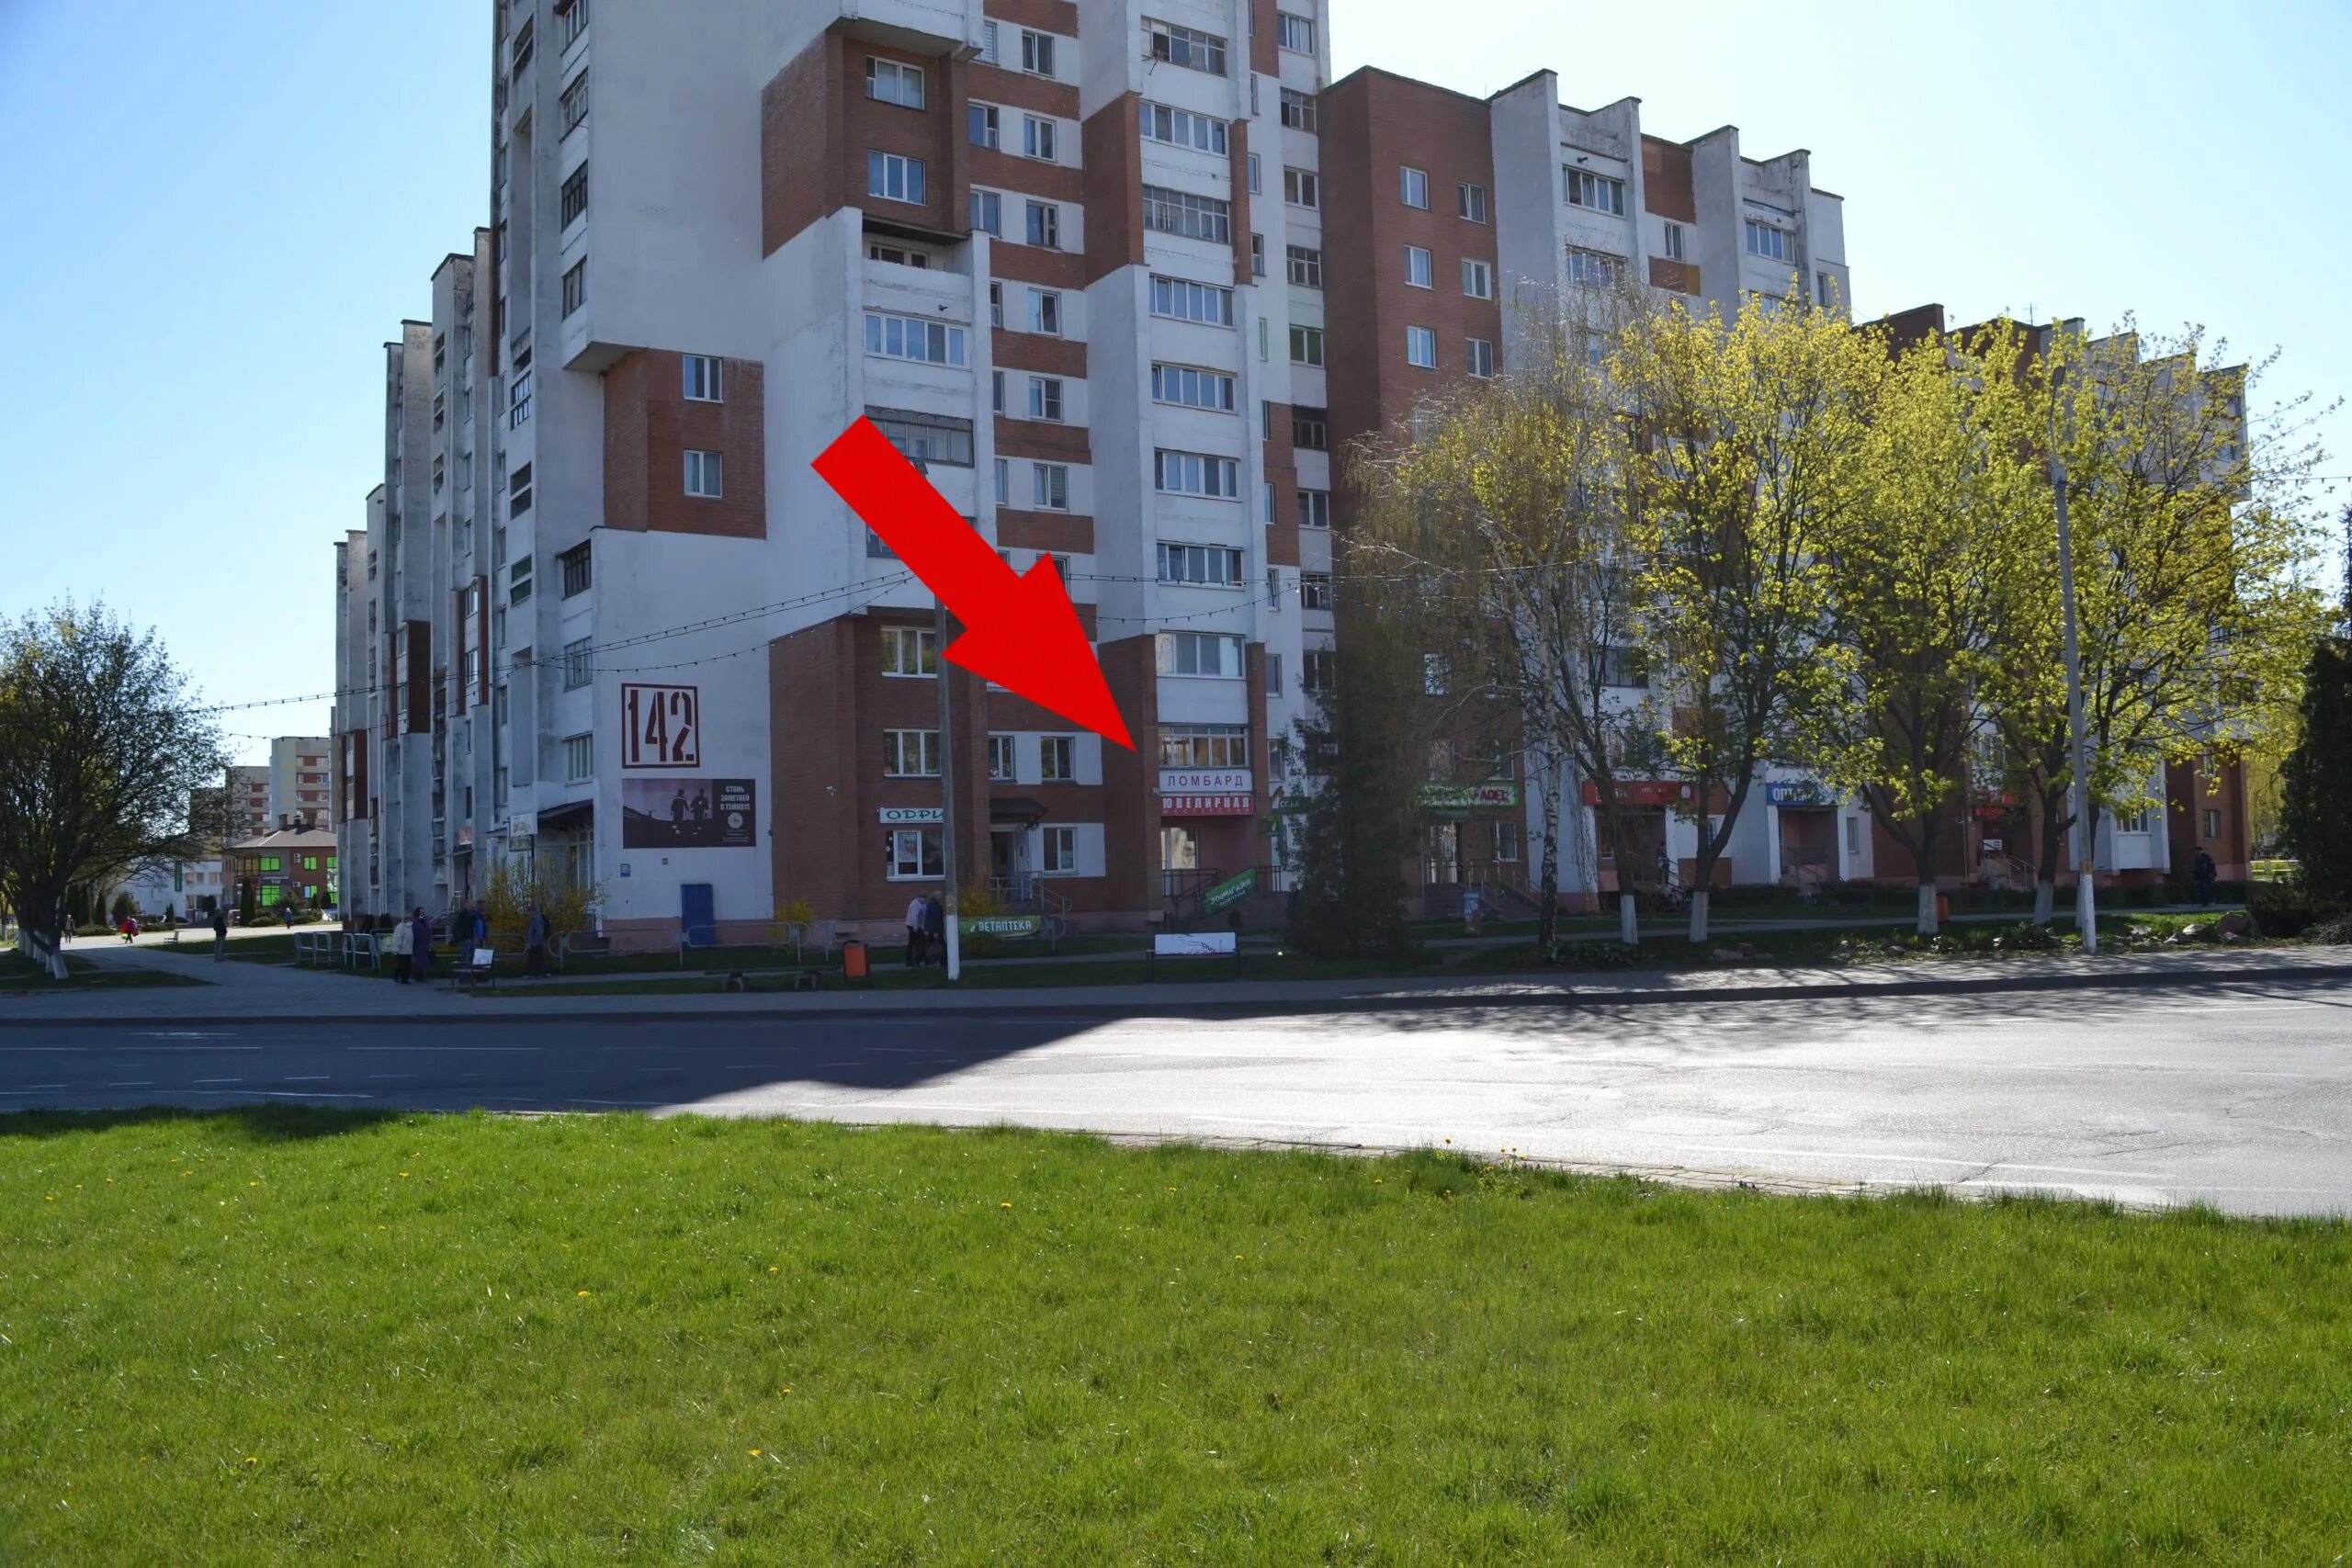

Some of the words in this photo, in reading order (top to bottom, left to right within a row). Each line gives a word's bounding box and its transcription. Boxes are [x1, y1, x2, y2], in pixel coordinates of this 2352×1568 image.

[628, 689, 695, 762] 142
[1168, 775, 1244, 787] ЛОМБАРД
[725, 785, 745, 794] СТАНЬ
[720, 794, 751, 802] ЗАМЕТНЕЙ
[1162, 796, 1250, 808] ЮВЕЛИРНАЯ
[978, 919, 1032, 932] ВЕТАПТЕКА
